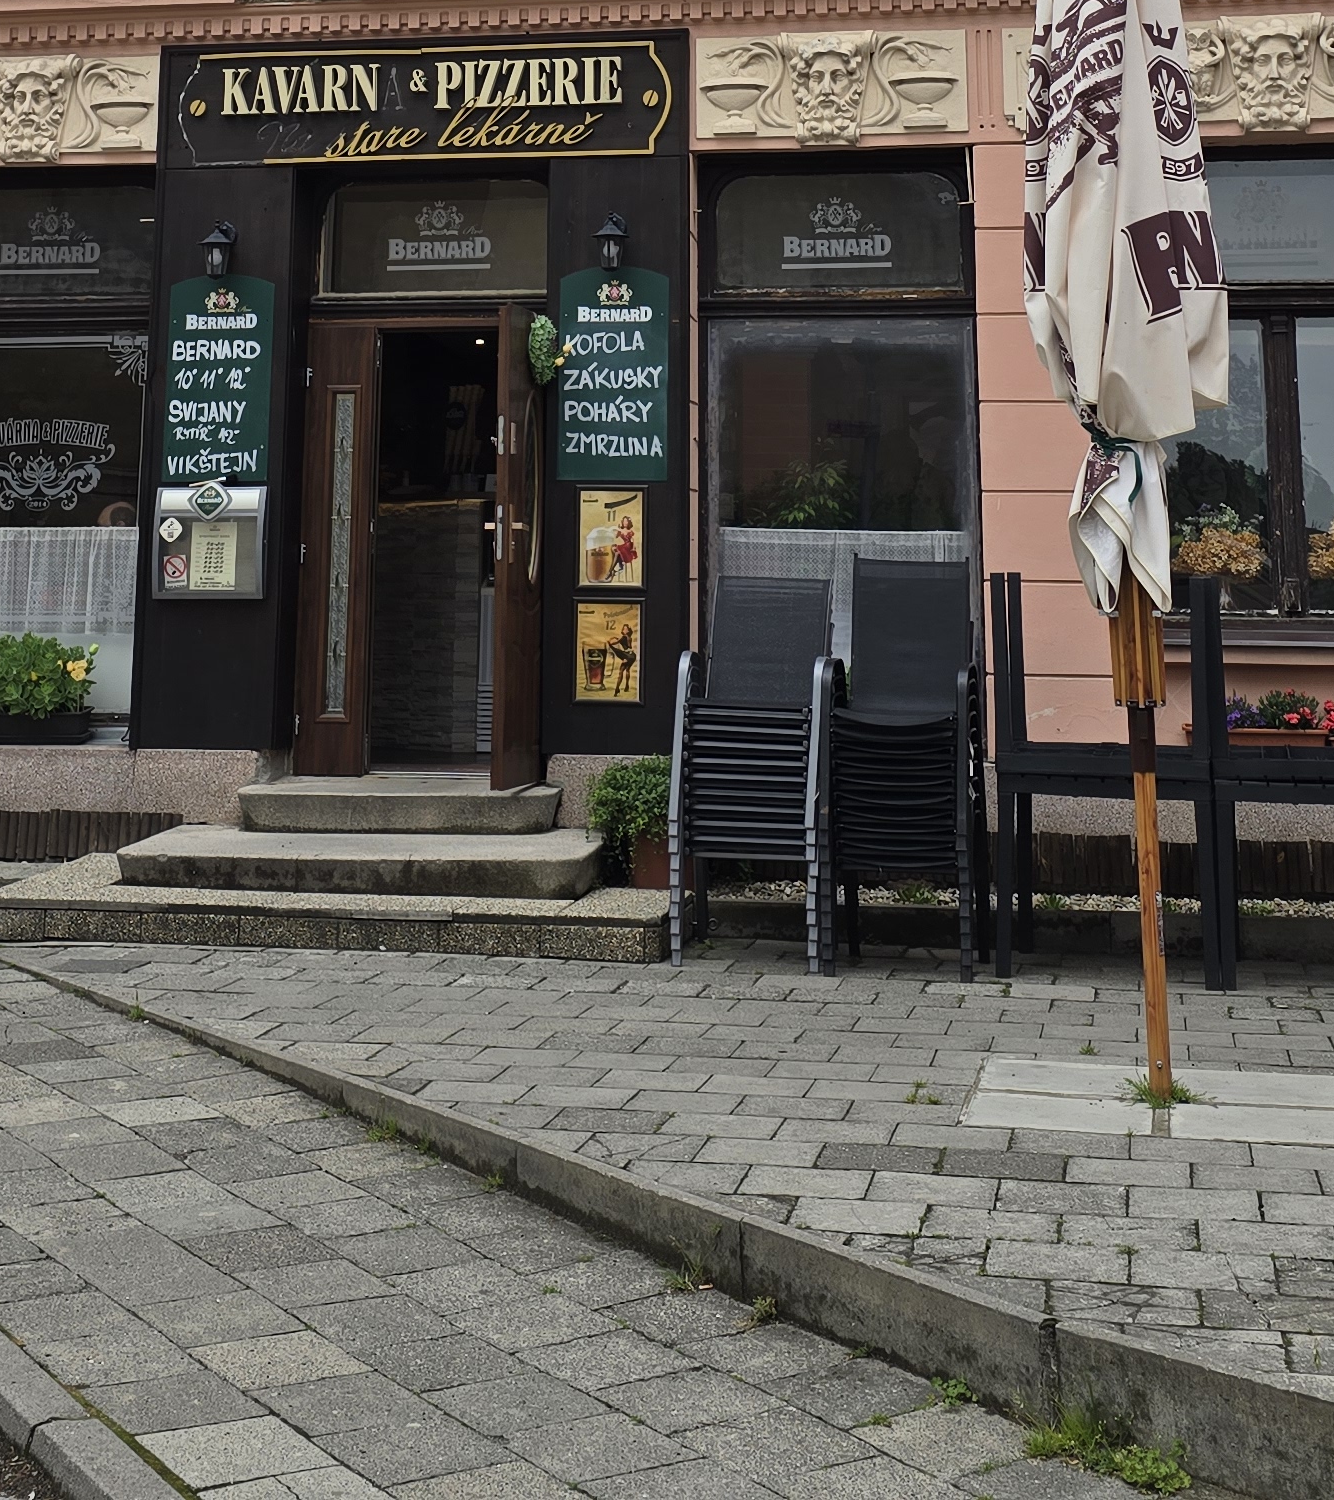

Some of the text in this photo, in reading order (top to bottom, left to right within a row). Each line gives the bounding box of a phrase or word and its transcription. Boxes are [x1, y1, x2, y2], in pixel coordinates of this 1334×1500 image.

[409, 68, 430, 93] &
[433, 56, 623, 110] PIZZERIE
[0, 242, 101, 265] BERNARD
[387, 236, 492, 261] BERNARD
[783, 235, 892, 258] BERNARD
[185, 313, 258, 330] BERNARD
[577, 305, 653, 323] BERNARD
[171, 338, 261, 362] BERNARD
[564, 330, 645, 357] KOFOLA
[563, 361, 663, 391] ZÁKUSKY
[168, 399, 247, 424] SVIJANY
[563, 395, 653, 423] POHÁRY
[42, 421, 51, 441] &
[51, 419, 110, 450] PIZZERIE
[565, 431, 664, 458] ZMRZLINA
[167, 447, 258, 476] VIKŠTEJN
